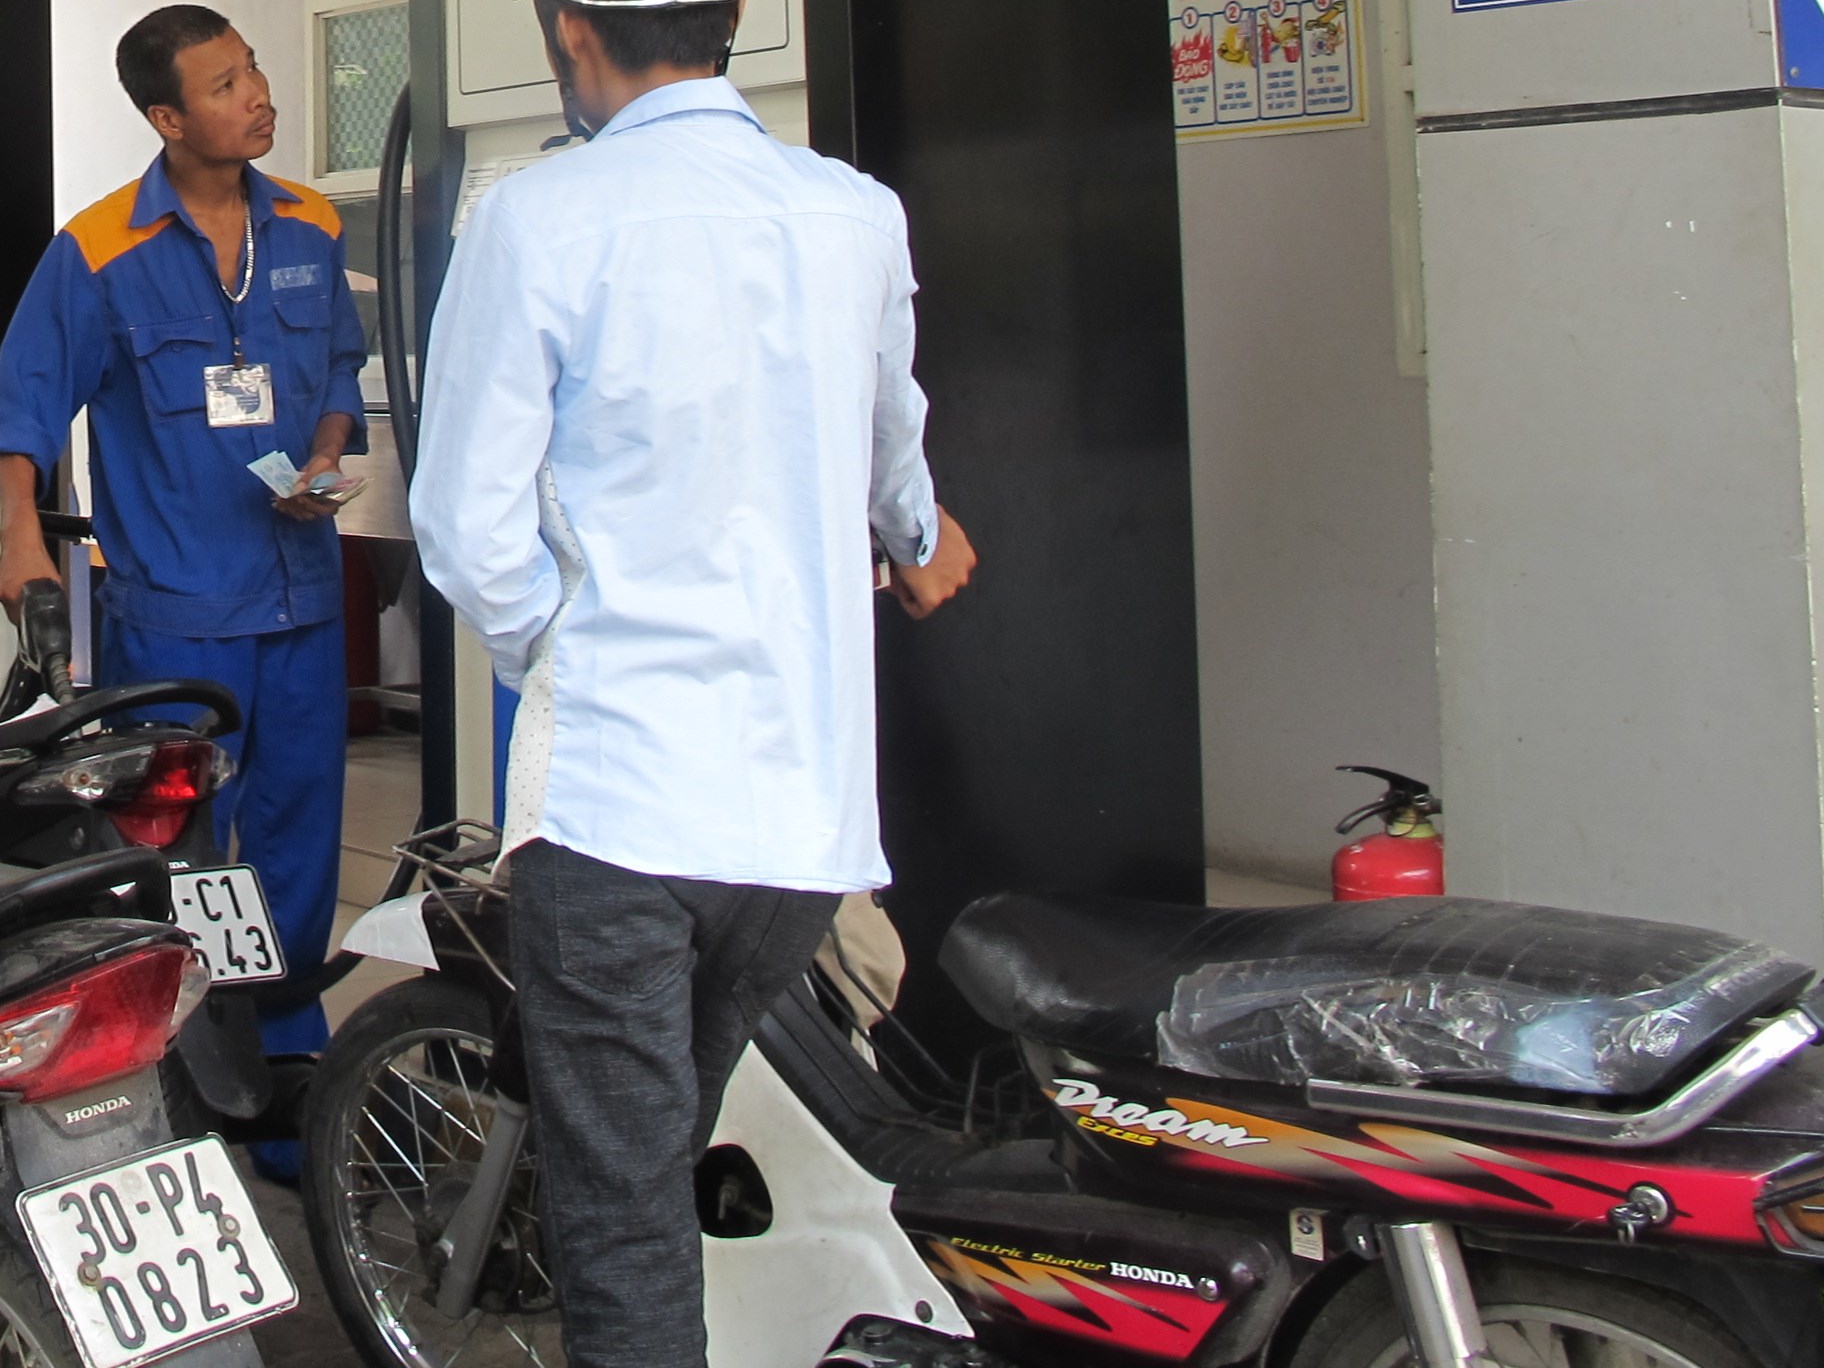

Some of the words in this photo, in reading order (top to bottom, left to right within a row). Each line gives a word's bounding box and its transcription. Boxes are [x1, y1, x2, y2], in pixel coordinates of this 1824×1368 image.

[64, 1095, 132, 1124] HONDA
[58, 1152, 222, 1264] 30-P4
[97, 1234, 264, 1350] 0823
[950, 1236, 1024, 1258] Electric
[1031, 1252, 1106, 1271] Starter
[1110, 1262, 1195, 1290] HONDA
